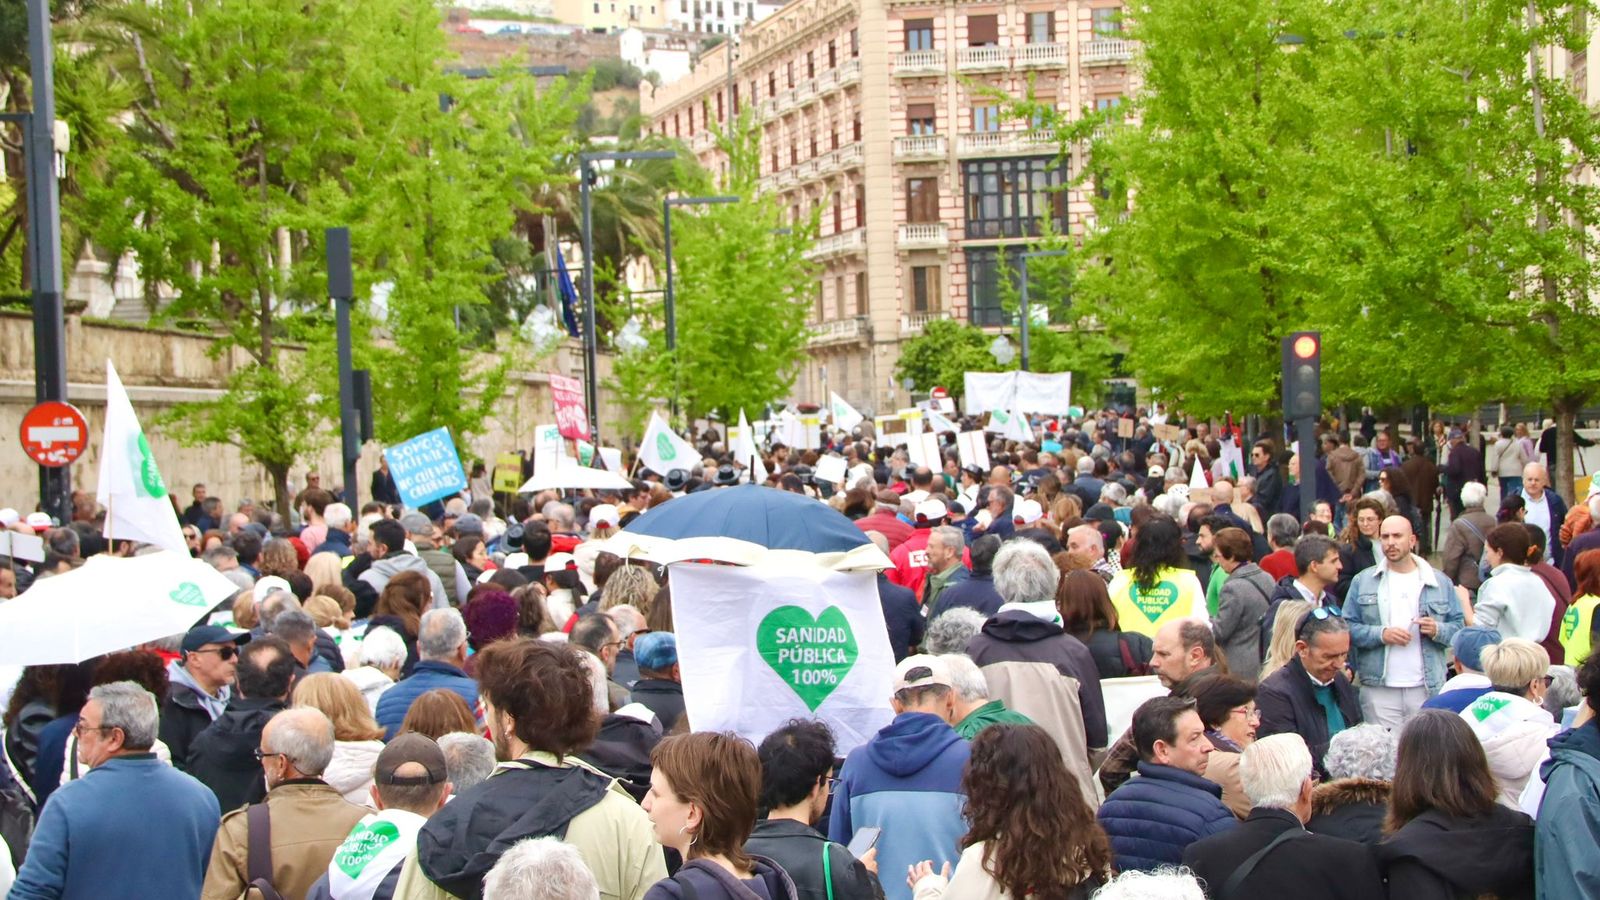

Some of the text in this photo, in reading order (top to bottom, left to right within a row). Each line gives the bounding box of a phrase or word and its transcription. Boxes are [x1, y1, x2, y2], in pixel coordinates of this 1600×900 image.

[775, 627, 847, 644] SANIDAD
[778, 645, 848, 664] PÚBLICA
[791, 668, 837, 685] 100%
